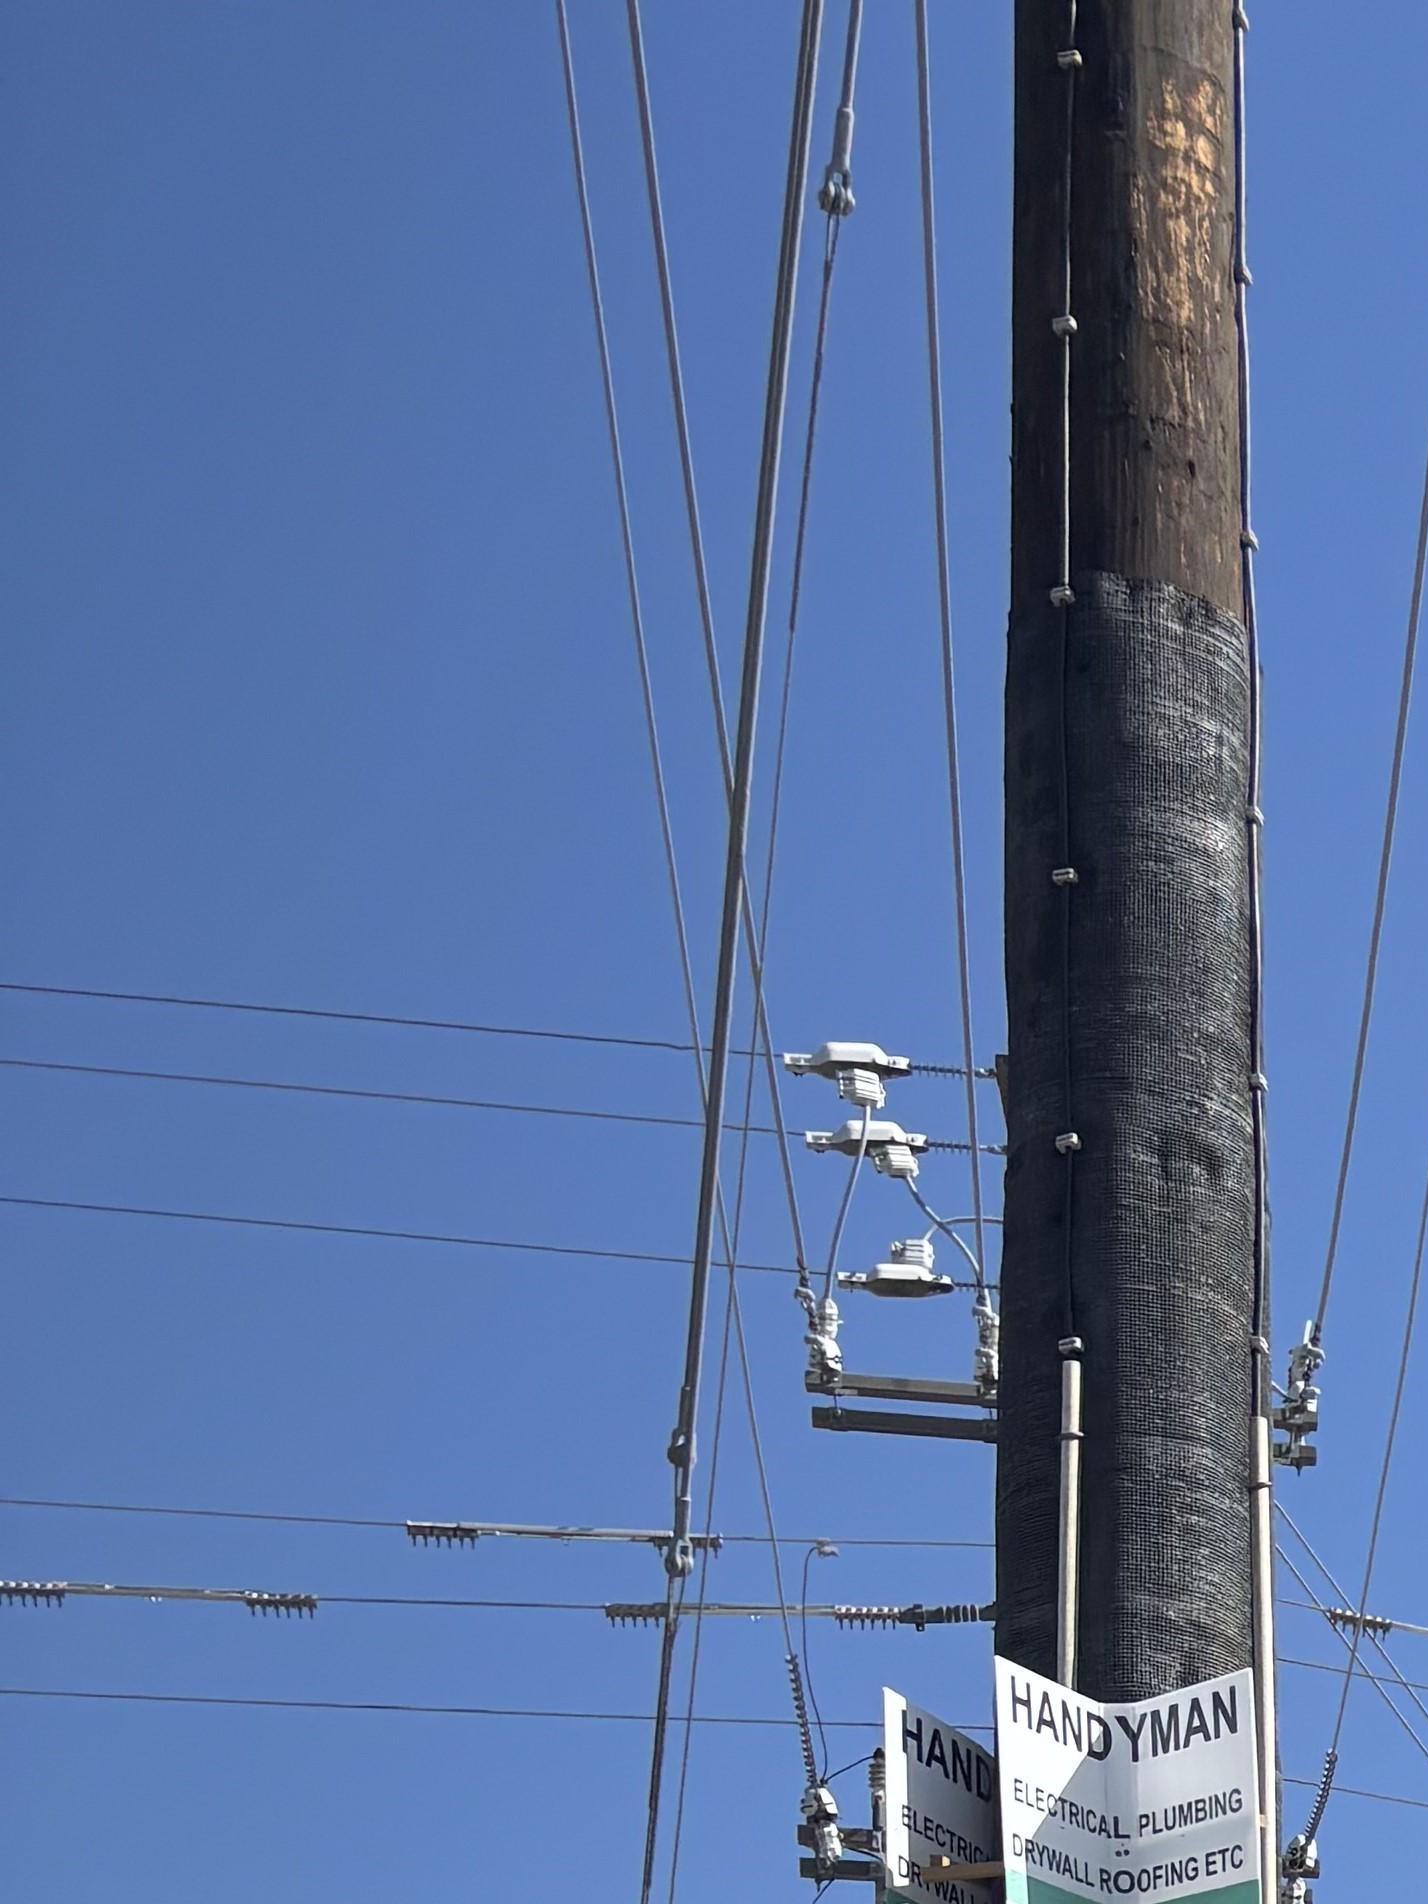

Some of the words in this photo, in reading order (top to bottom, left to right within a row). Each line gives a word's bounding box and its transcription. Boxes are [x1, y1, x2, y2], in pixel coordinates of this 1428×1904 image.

[1011, 1675, 1239, 1763] HANDYMAN
[1014, 1778, 1131, 1840] ELECTRICAL
[1139, 1789, 1243, 1838] PLUMBING
[1012, 1833, 1095, 1888] DRYWALL
[1100, 1857, 1200, 1895] ROOFING
[1205, 1845, 1244, 1878] ETC
